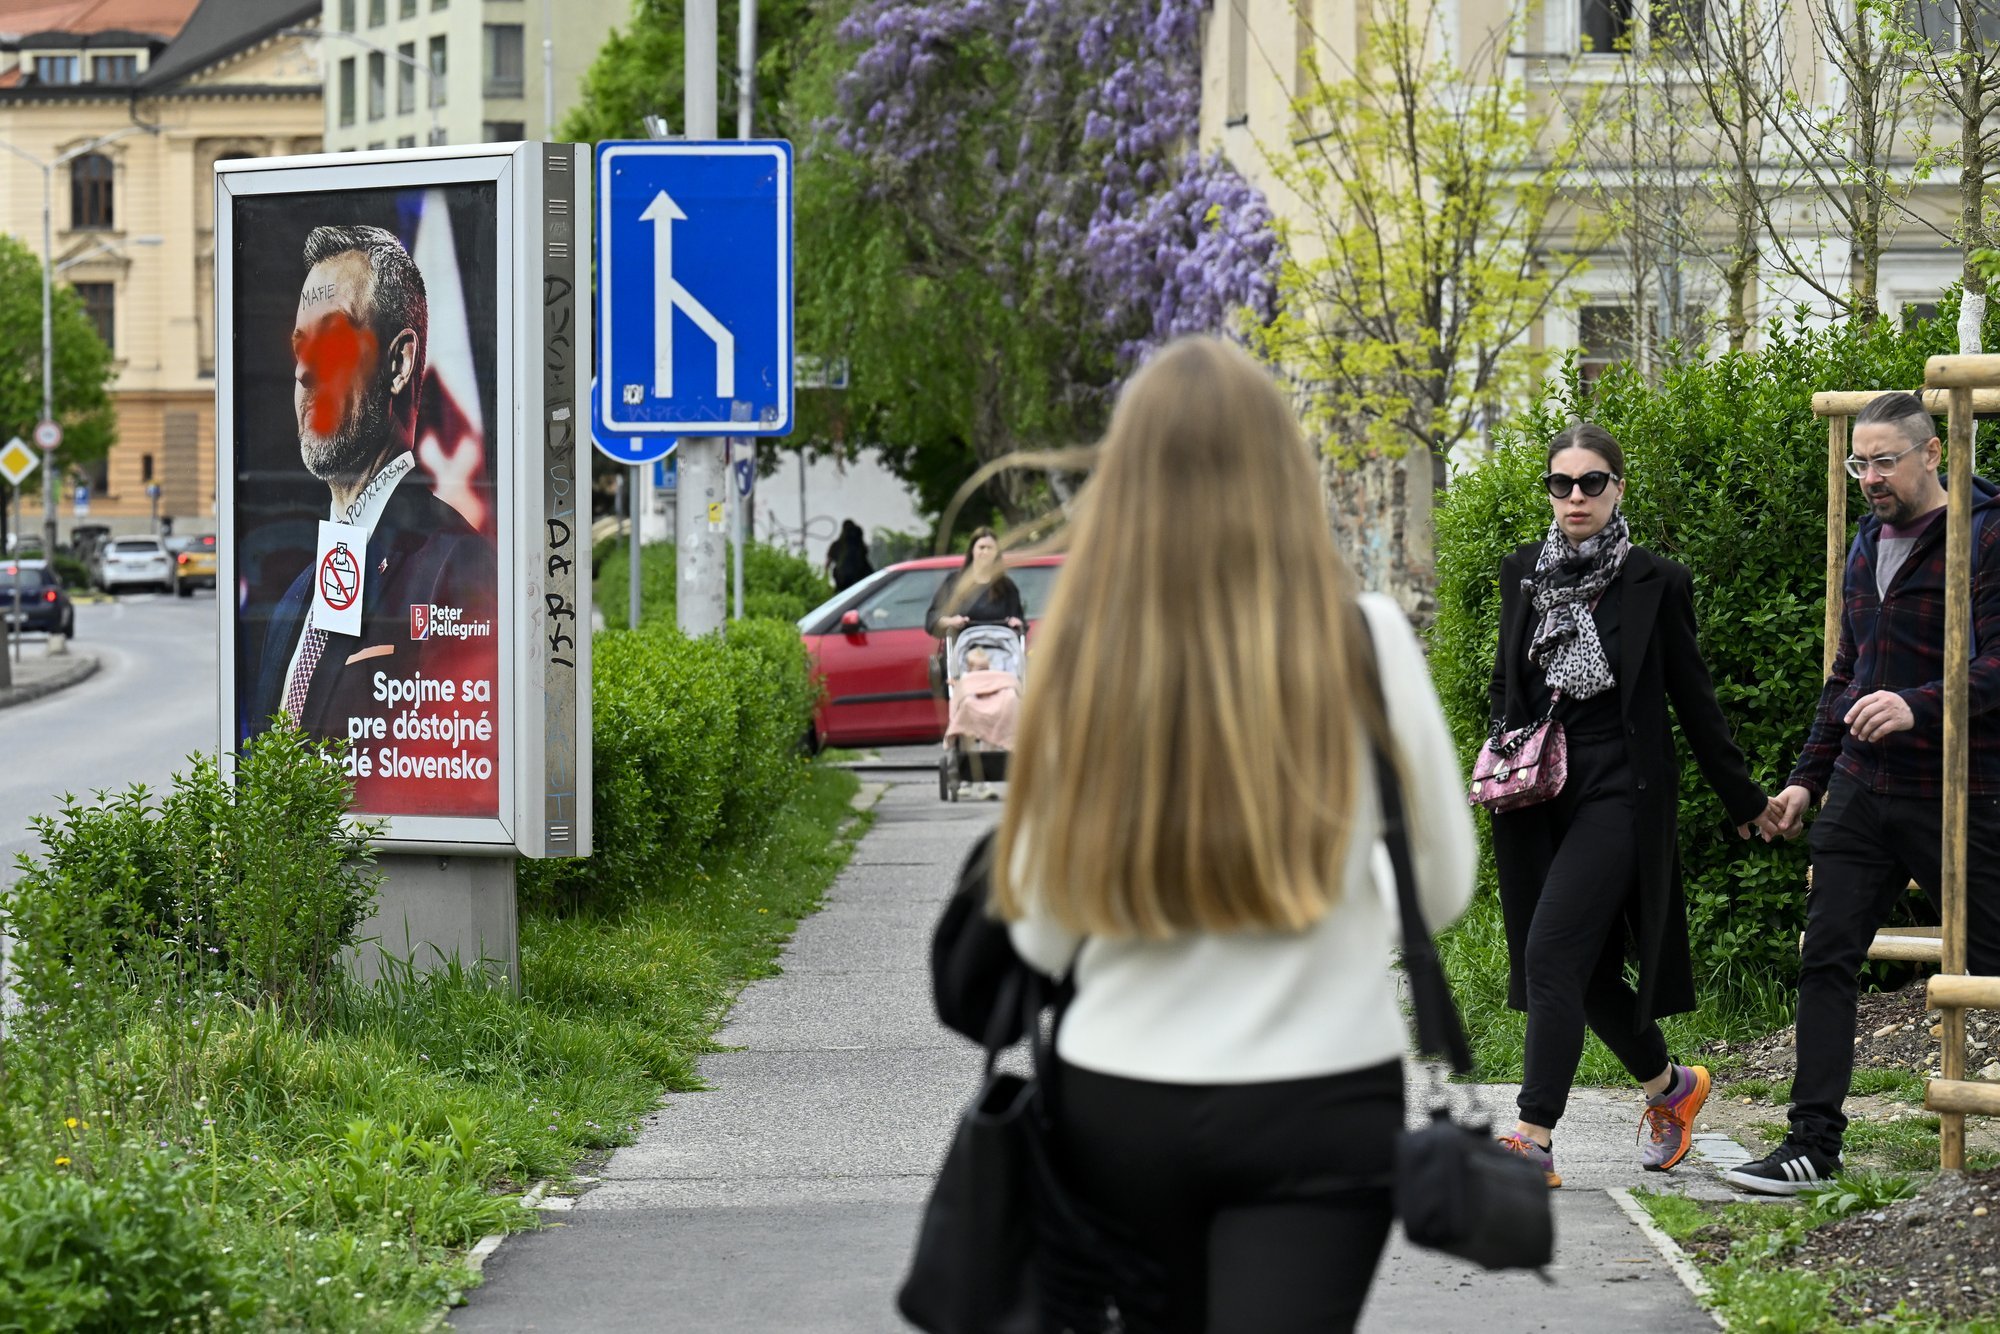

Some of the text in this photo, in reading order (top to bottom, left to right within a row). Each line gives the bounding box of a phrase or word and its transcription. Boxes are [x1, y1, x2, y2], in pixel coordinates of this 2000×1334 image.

[301, 283, 335, 311] MAFIE
[429, 604, 463, 620] Peter
[429, 620, 490, 640] Pellegrini
[373, 671, 490, 709] Spojme sa
[348, 710, 492, 748] pre dôstojné
[378, 747, 492, 779] Slovensko
